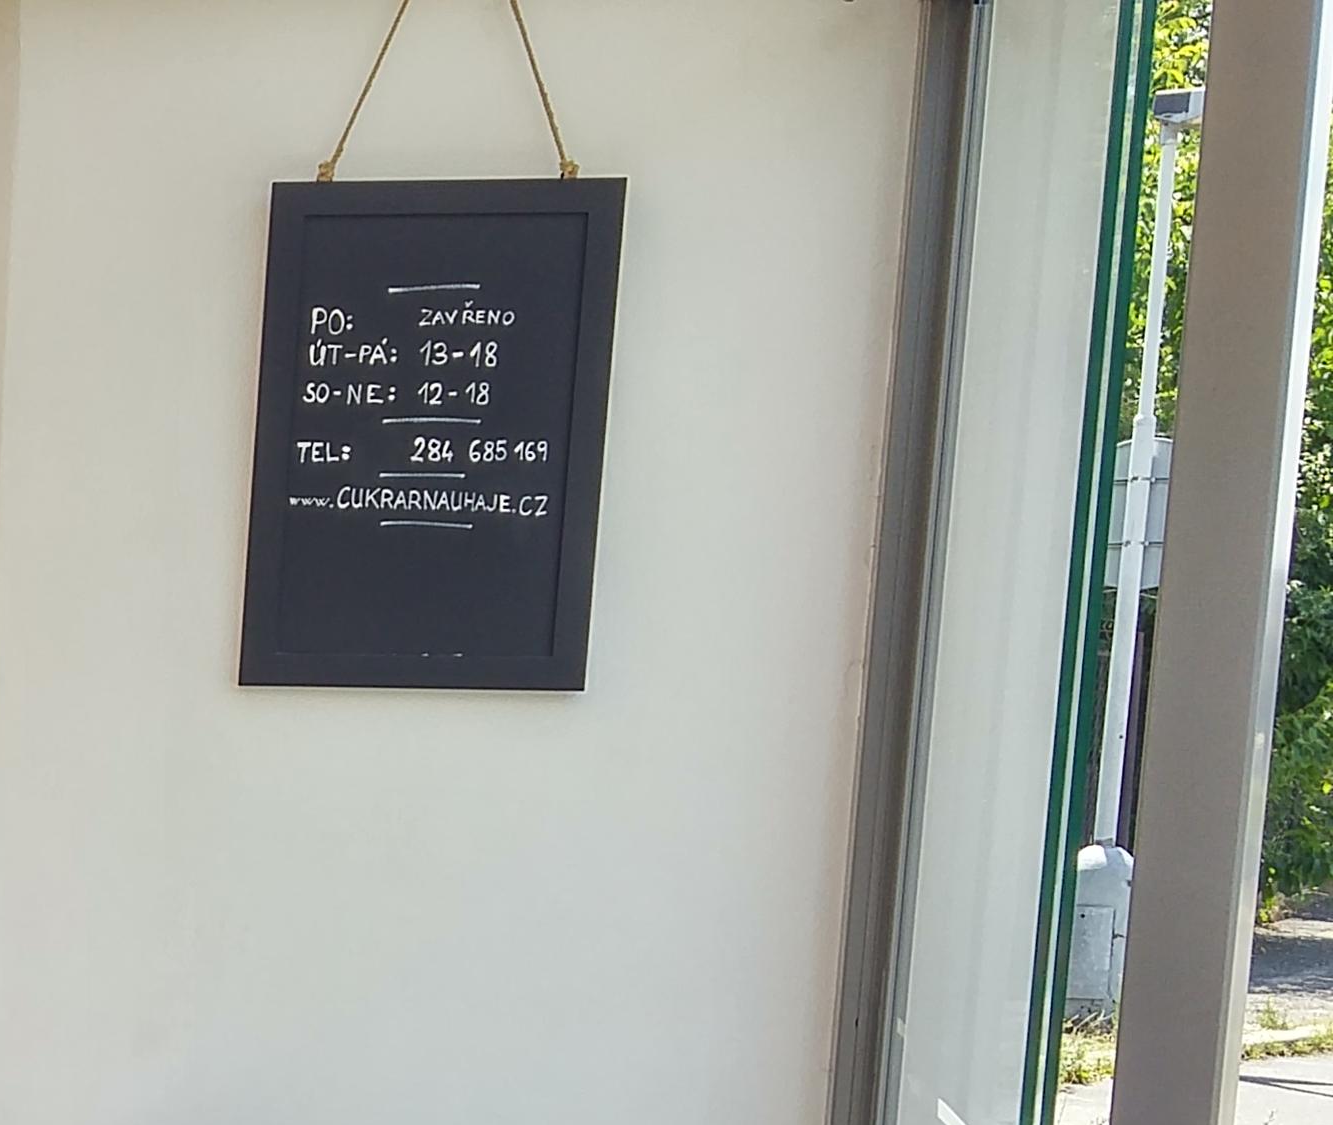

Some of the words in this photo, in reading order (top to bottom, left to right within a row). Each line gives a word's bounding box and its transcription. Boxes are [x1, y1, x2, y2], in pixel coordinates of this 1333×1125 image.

[311, 307, 354, 334] PO:
[418, 301, 515, 326] ZAVŘENO
[309, 339, 398, 366] ÚT-PÁ:
[419, 341, 499, 367] 13-18
[302, 383, 396, 404] SO-NE:
[297, 441, 351, 463] TEL:
[409, 436, 453, 462] 284
[469, 439, 508, 462] 685
[513, 440, 548, 461] 169
[289, 486, 548, 517] www.CUKRARNAUHAJE.CZ
